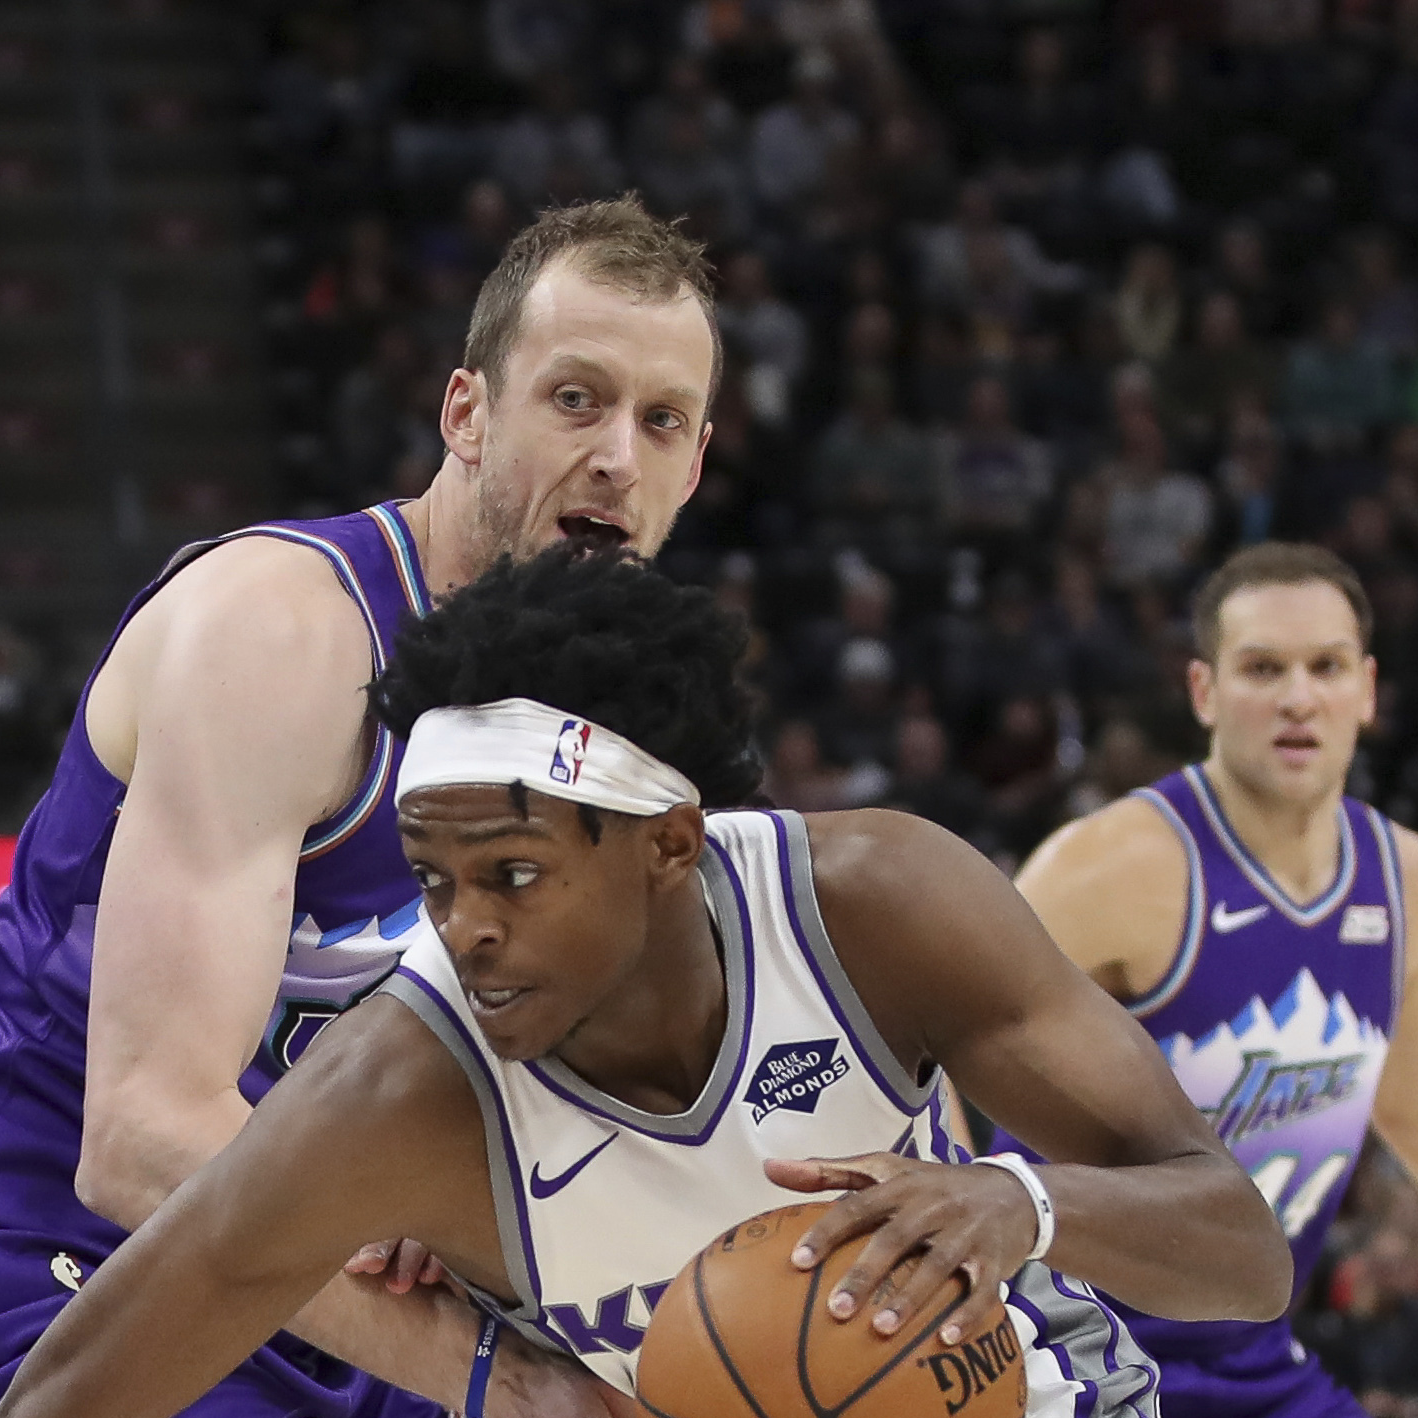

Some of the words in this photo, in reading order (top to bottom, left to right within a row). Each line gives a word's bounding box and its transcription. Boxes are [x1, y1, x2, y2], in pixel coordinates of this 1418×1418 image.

[759, 1051, 821, 1094] DIAMOND
[767, 1051, 802, 1076] BLUE
[754, 1060, 847, 1120] ALMONDS
